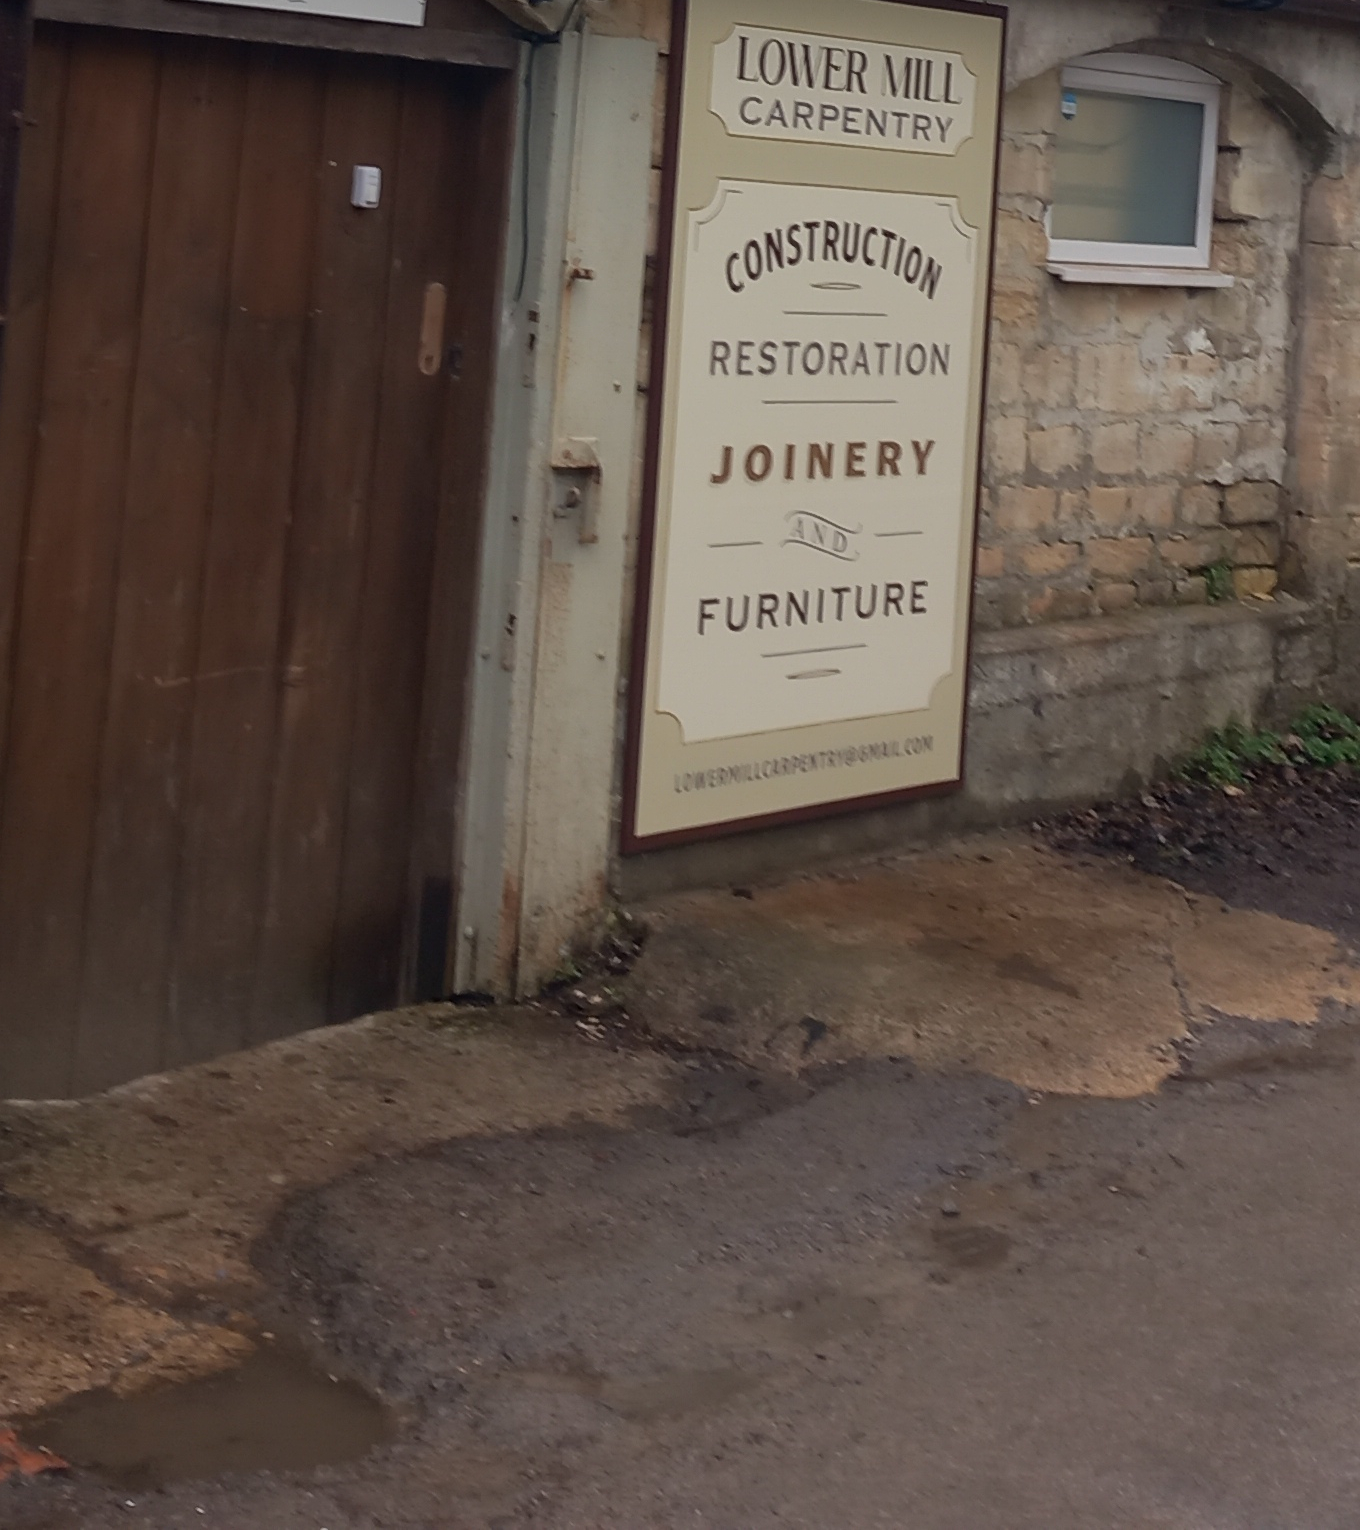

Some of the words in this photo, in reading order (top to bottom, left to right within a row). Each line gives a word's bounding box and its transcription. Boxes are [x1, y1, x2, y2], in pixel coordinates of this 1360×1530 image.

[736, 35, 868, 95] LOWER
[881, 52, 962, 106] MILL
[739, 96, 954, 144] CARPENTRY
[725, 220, 944, 301] CONSTRUCTION
[709, 340, 951, 377] RESTORATION
[710, 439, 936, 485] JOINERY
[790, 516, 849, 554] AND
[697, 580, 929, 636] FURNITURE
